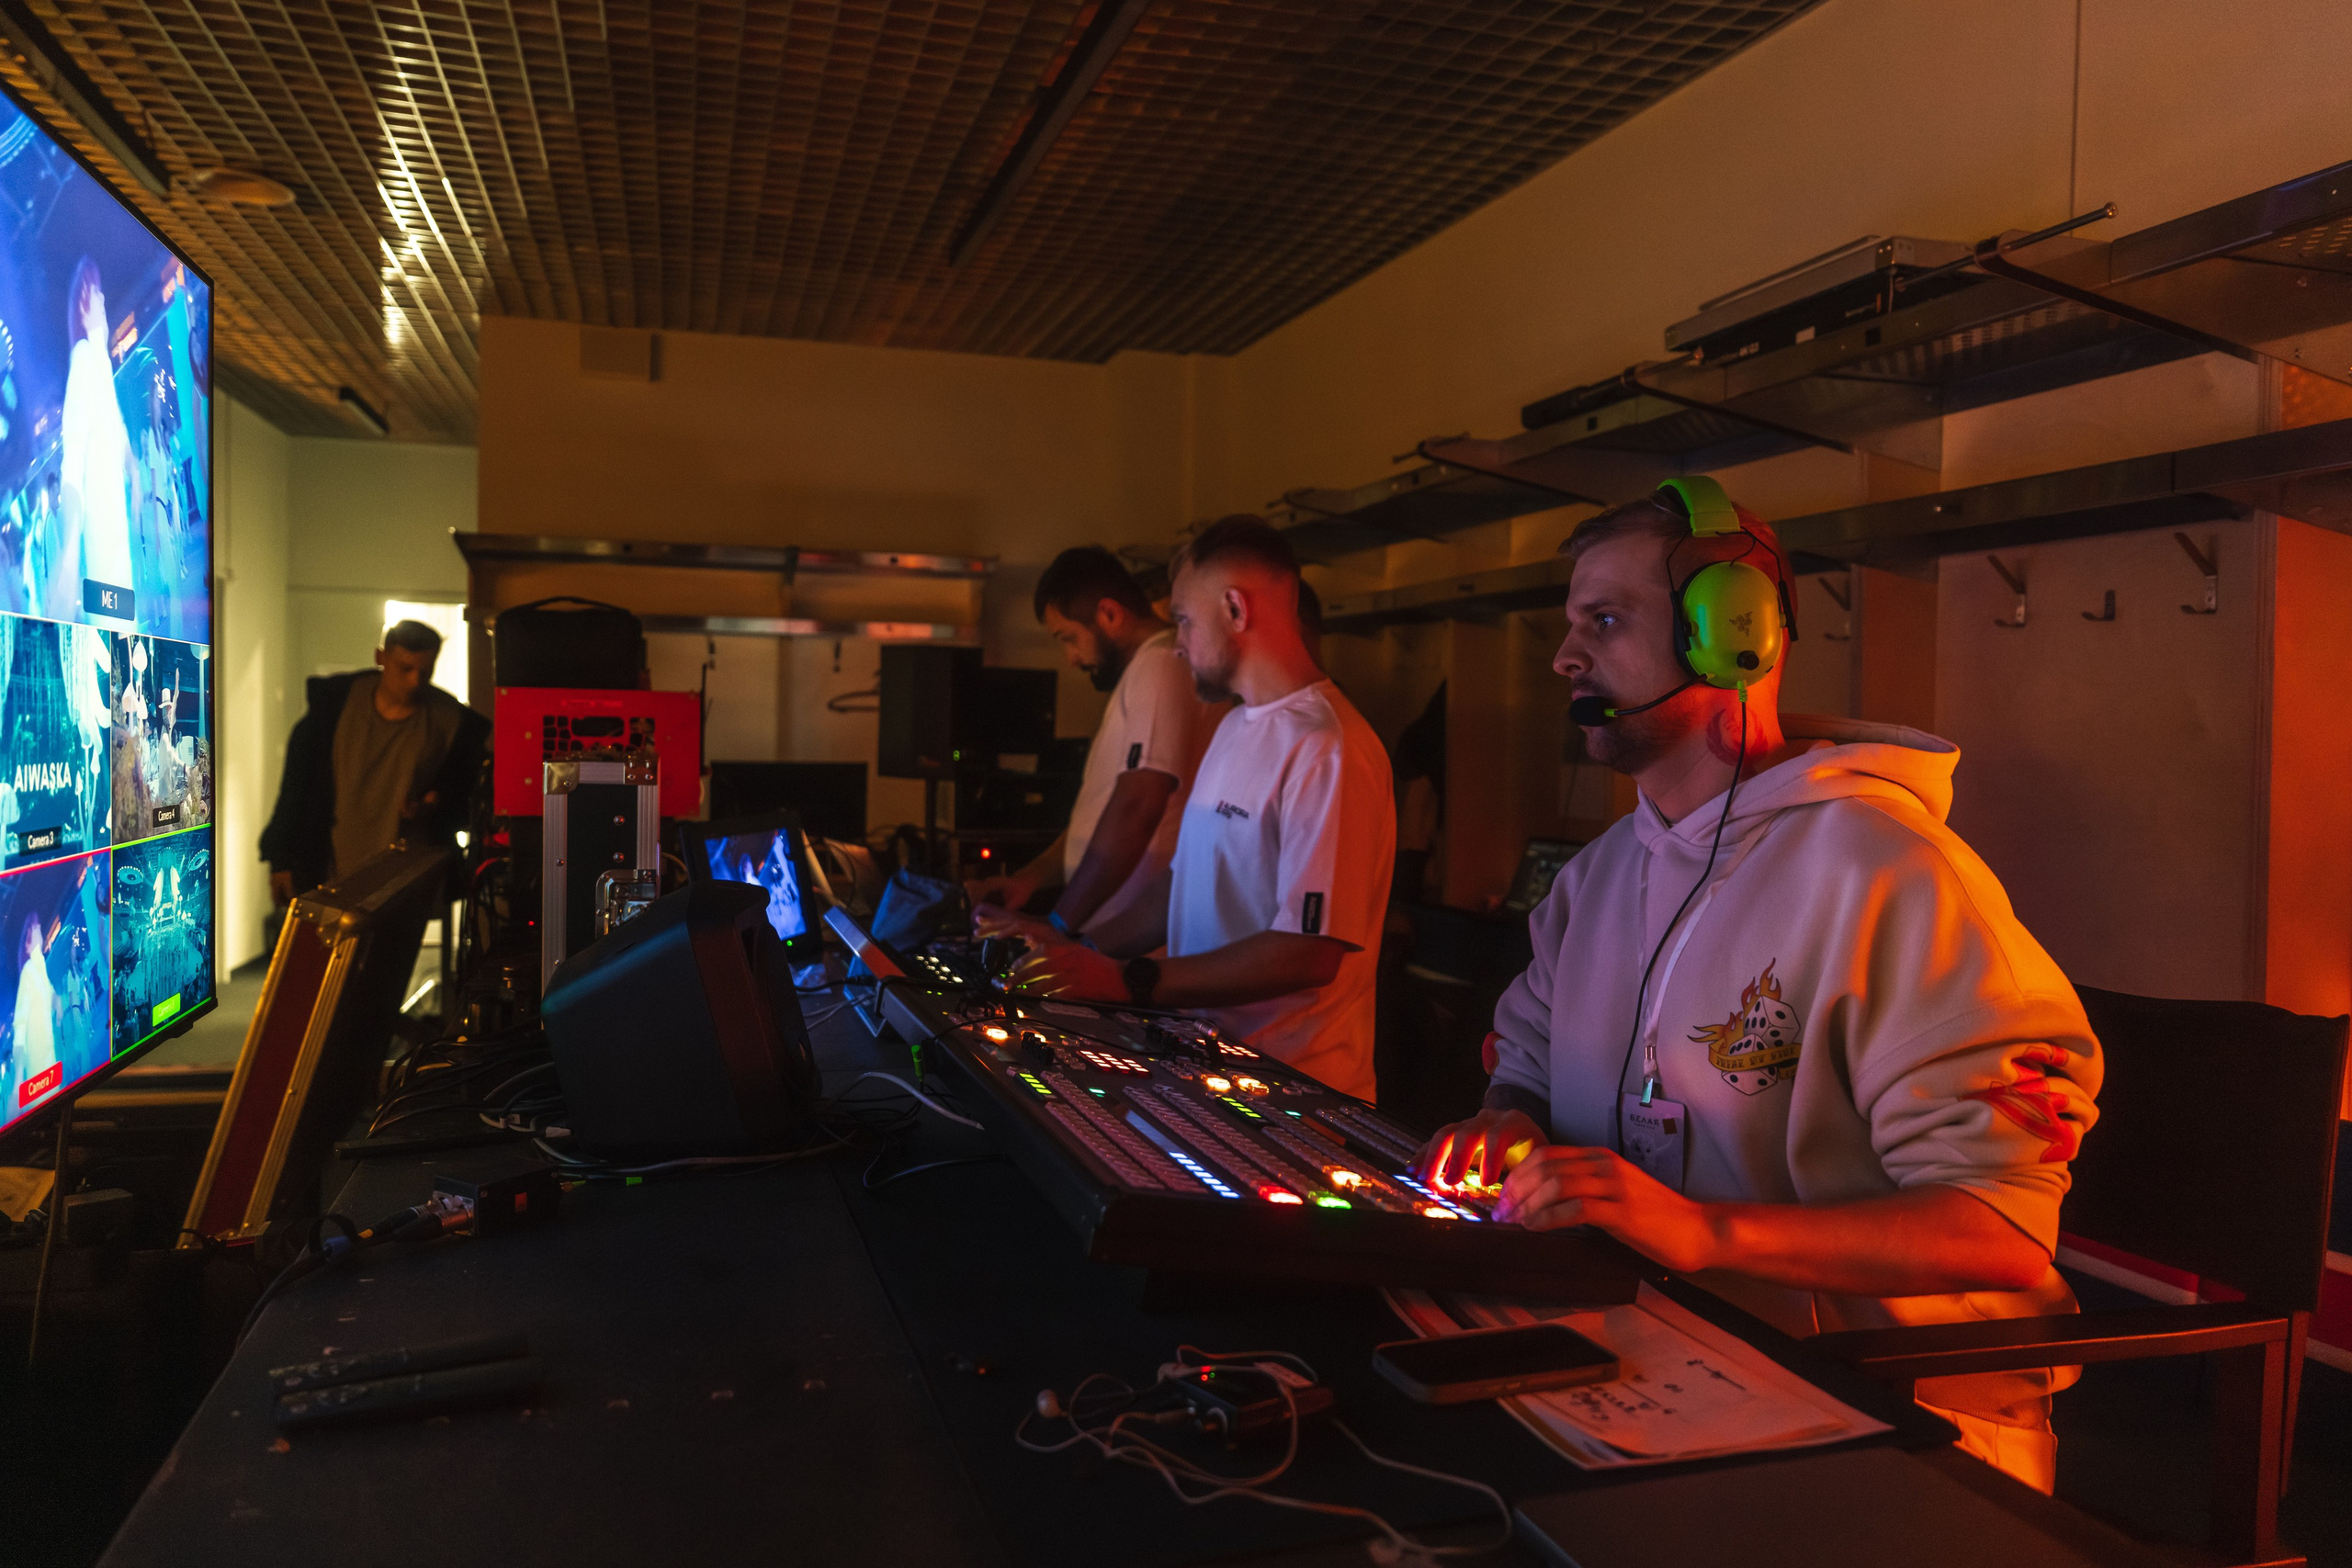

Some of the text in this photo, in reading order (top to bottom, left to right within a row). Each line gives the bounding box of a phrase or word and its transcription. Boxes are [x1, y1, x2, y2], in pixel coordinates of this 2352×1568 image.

[102, 590, 118, 610] ME 1
[13, 761, 72, 793] AIWASKA
[158, 810, 172, 822] Camera
[28, 830, 54, 850] Camera 3
[28, 1069, 54, 1097] Camera 7
[1630, 1114, 1659, 1126] БЕЛАЯ
